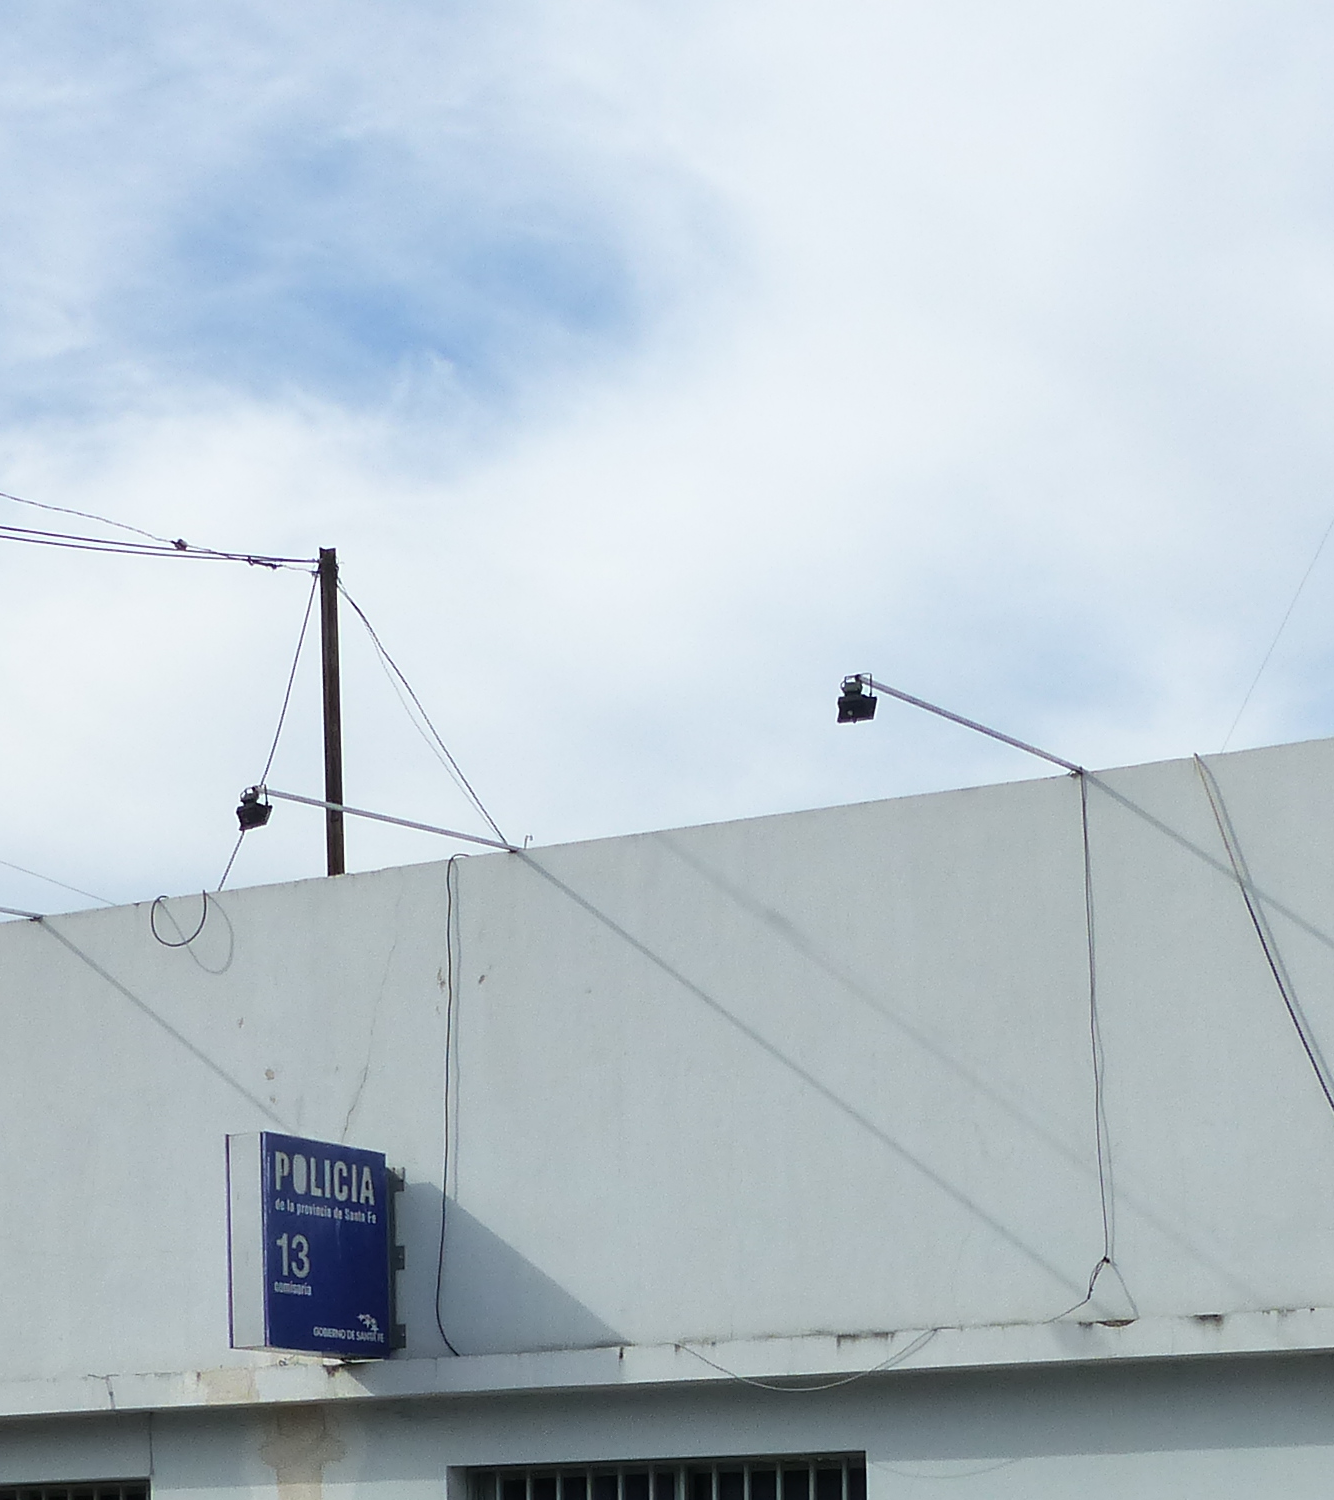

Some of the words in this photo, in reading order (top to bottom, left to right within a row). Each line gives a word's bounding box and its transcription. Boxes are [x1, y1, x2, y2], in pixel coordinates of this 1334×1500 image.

[275, 1151, 375, 1206] POLICIA
[296, 1202, 332, 1219] provincia
[344, 1208, 366, 1223] Santa
[367, 1210, 377, 1225] Fe
[276, 1233, 310, 1279] 13
